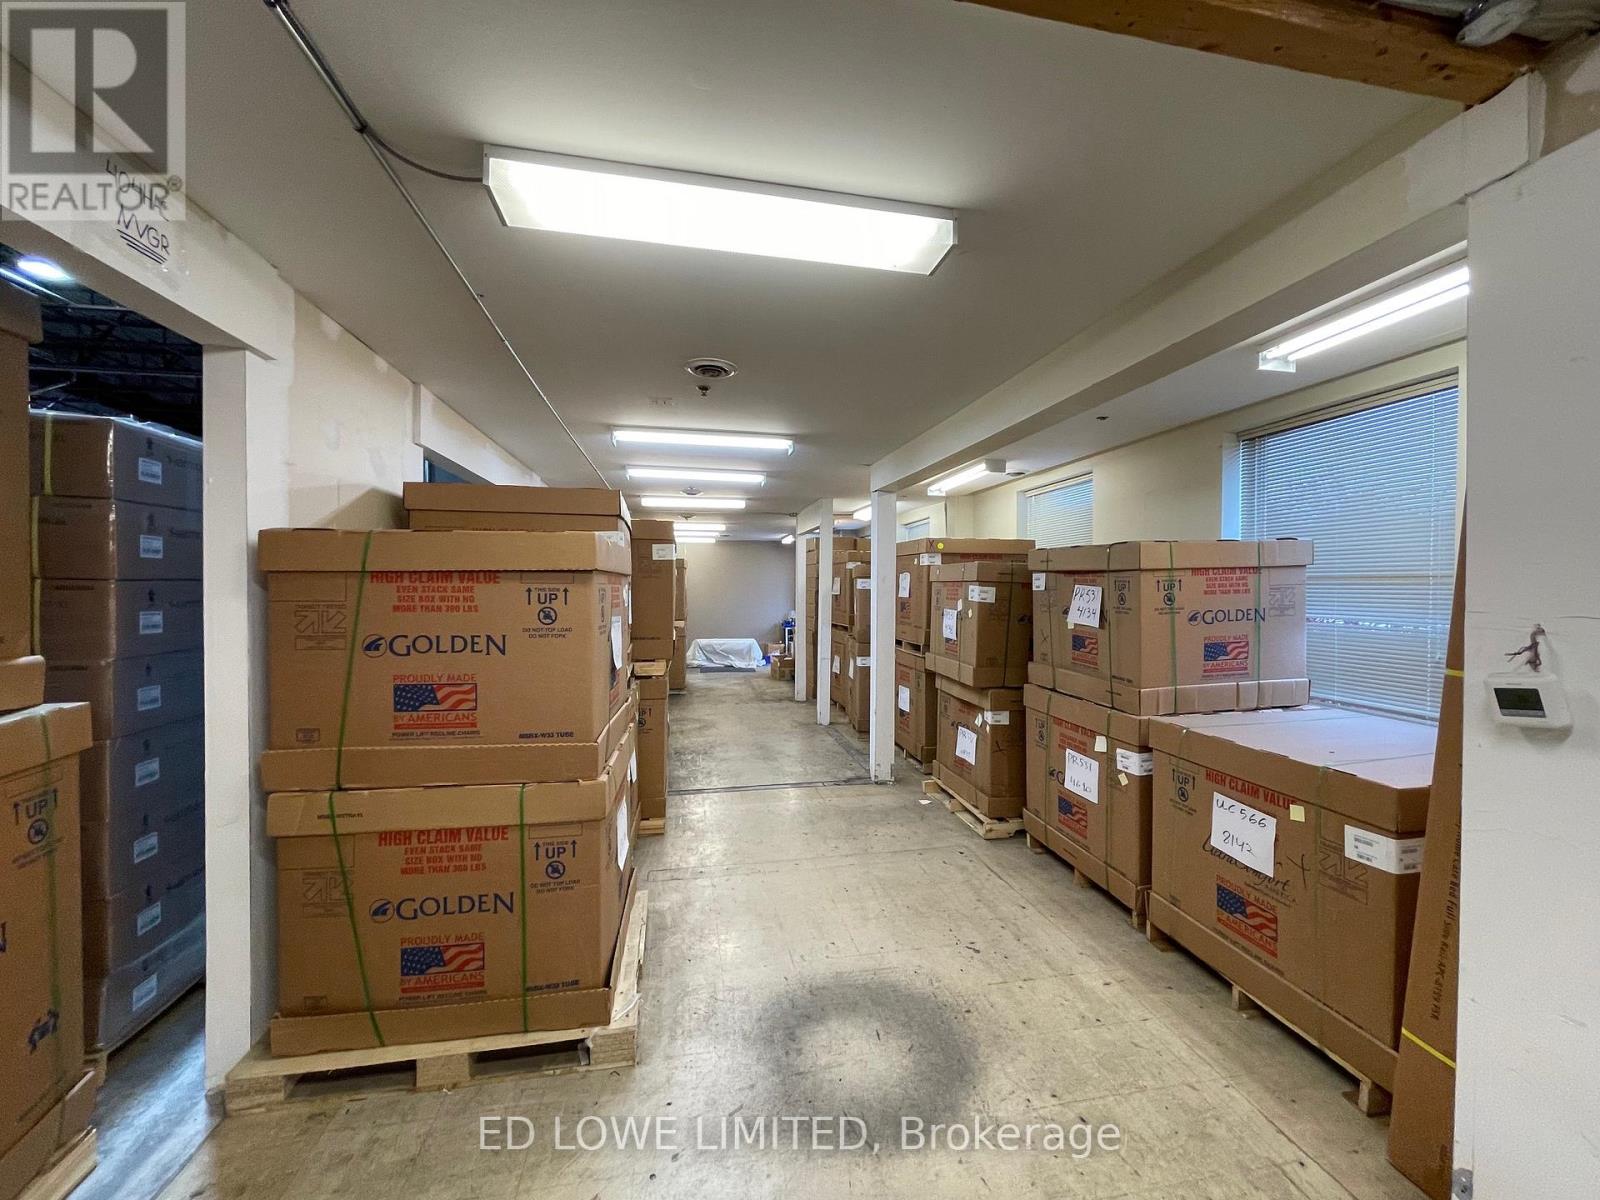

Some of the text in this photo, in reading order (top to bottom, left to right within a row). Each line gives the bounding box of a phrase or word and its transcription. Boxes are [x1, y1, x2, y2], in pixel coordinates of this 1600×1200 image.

[370, 571, 500, 584] HIGH CLAIM VALUE
[1163, 583, 1176, 592] UP
[537, 592, 558, 605] UP
[1077, 605, 1097, 619] 4134
[1202, 607, 1266, 625] GOLDEN
[388, 634, 506, 656] GOLDEN
[392, 674, 476, 684] PROUDLY MADE
[408, 712, 478, 722] AMERICANS
[1177, 776, 1190, 787] UP
[1206, 769, 1226, 788] HIGH
[1229, 777, 1260, 800] CLAIM
[26, 800, 48, 818] UP
[378, 826, 510, 847] HIGH CLAIM VALUE
[545, 846, 566, 859] UP
[396, 892, 514, 920] GOLDEN
[1446, 900, 1458, 920] Full
[400, 932, 484, 946] PROUDLY MADE
[415, 972, 484, 984] AMERICANS
